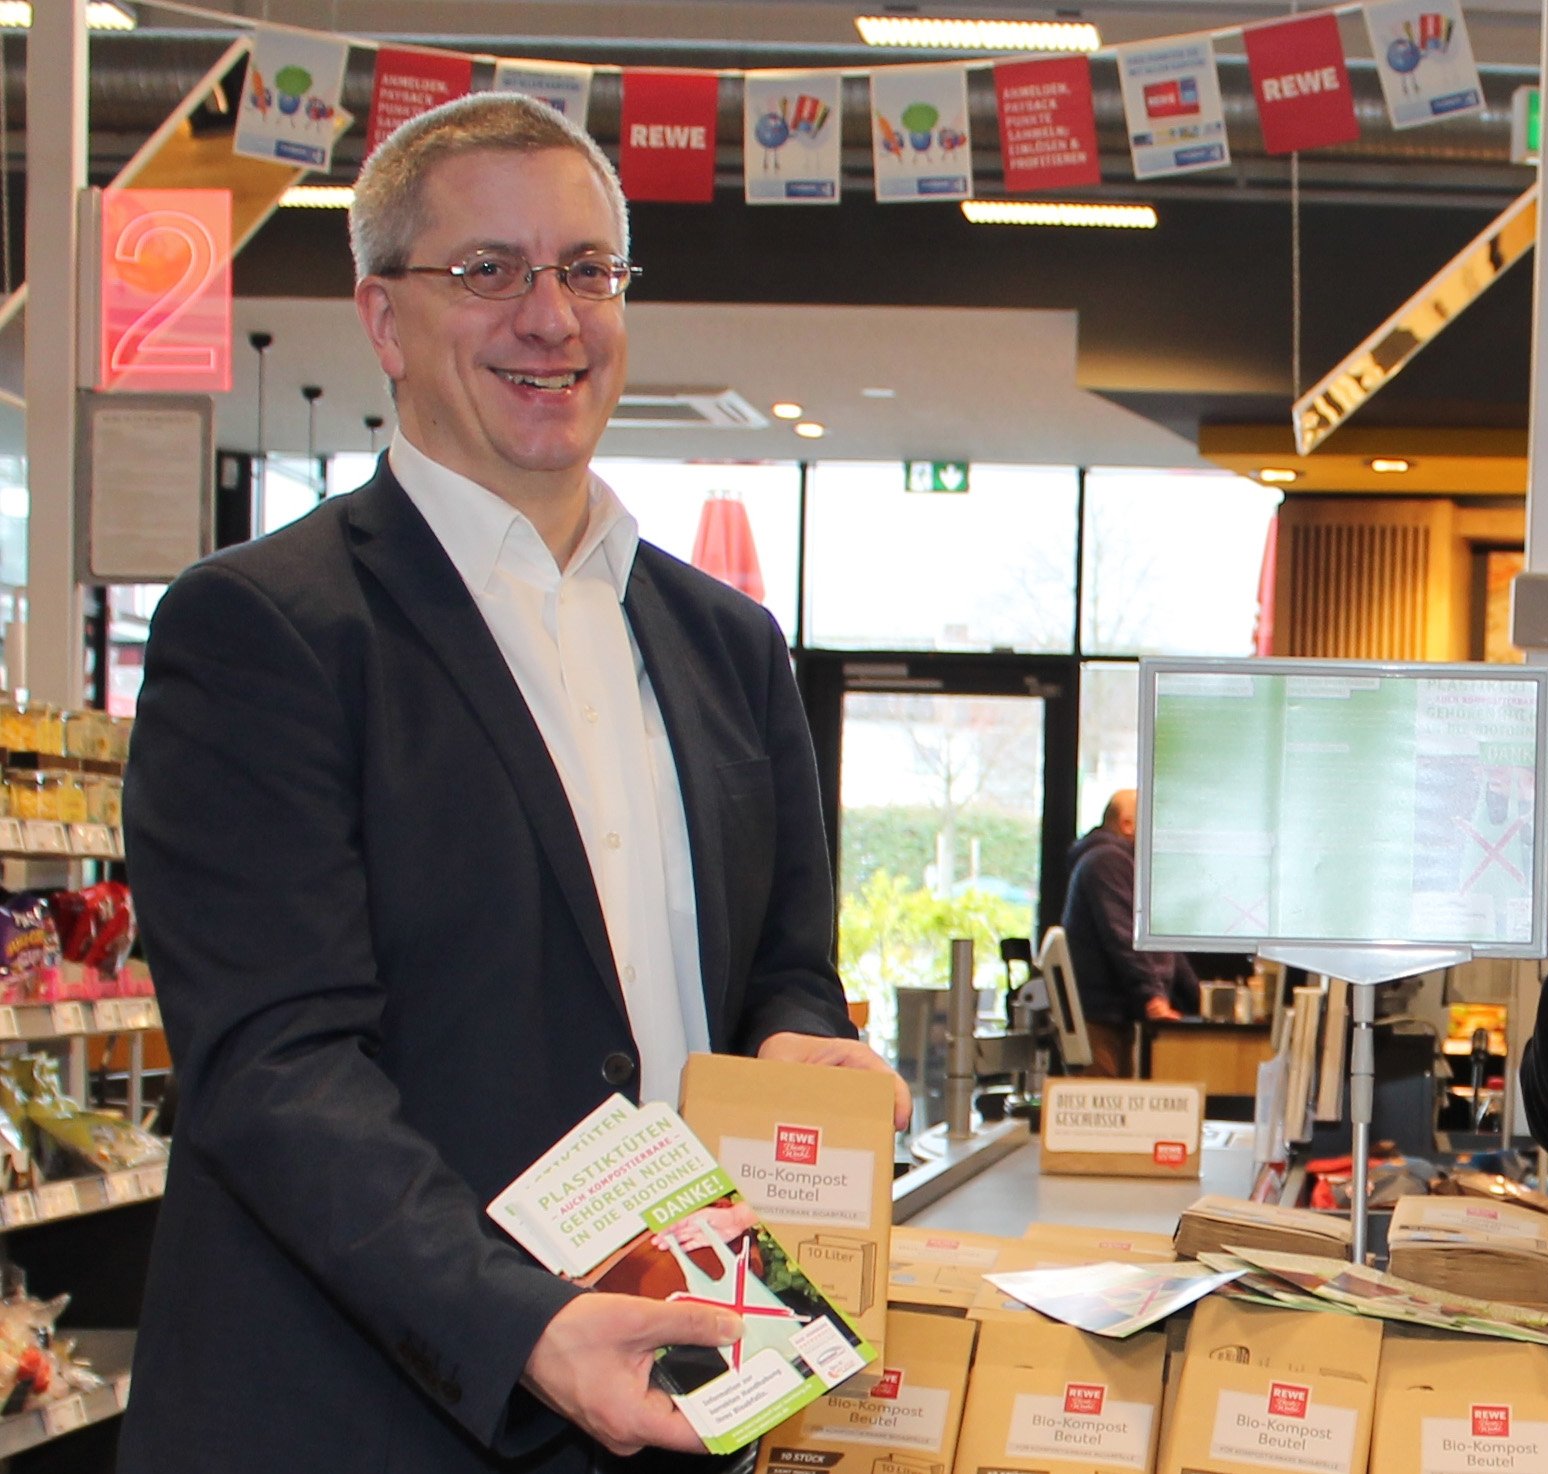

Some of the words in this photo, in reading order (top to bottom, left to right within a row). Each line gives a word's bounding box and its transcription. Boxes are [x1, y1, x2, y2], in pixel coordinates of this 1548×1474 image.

[1261, 66, 1340, 102] REWE
[629, 124, 707, 150] REWE
[112, 210, 217, 373] 2
[1057, 1093, 1086, 1108] DIESE
[1092, 1095, 1123, 1110] KASSE
[1128, 1096, 1144, 1111] IST
[1148, 1097, 1189, 1112] GERADE
[1056, 1112, 1126, 1128] GESCHLOSSEN
[779, 1131, 816, 1146] REWE
[538, 1116, 673, 1212] PLASTIKTÜTEN
[559, 1195, 587, 1215] AUCH
[588, 1137, 672, 1195] KOMPOSTIERBARE
[741, 1163, 848, 1188] Bio-Kompost
[559, 1177, 637, 1235] GEHÖREN
[640, 1142, 692, 1180] NICHT
[766, 1184, 821, 1202] Beutel
[570, 1231, 592, 1249] IN
[592, 1209, 621, 1231] DIE
[622, 1156, 705, 1213] BIOTONNE!
[651, 1174, 725, 1224] DANKE!
[808, 1247, 822, 1259] 10
[825, 1248, 855, 1262] Liter
[1069, 1388, 1102, 1400] REWE
[1273, 1388, 1306, 1401] REWE
[828, 1396, 924, 1418] Bio-Kompost
[1474, 1410, 1506, 1420] REWE
[849, 1412, 898, 1428] Beutel
[1032, 1414, 1128, 1434] Bio-Kompost
[1236, 1413, 1332, 1440] Bio-Kompost
[1054, 1430, 1102, 1445] Beutel
[1258, 1433, 1307, 1450] Beutel
[1442, 1440, 1538, 1456] Bio-Kompost
[781, 1452, 790, 1461] 10
[793, 1452, 825, 1463] STÜCK
[1467, 1455, 1514, 1468] Beutel
